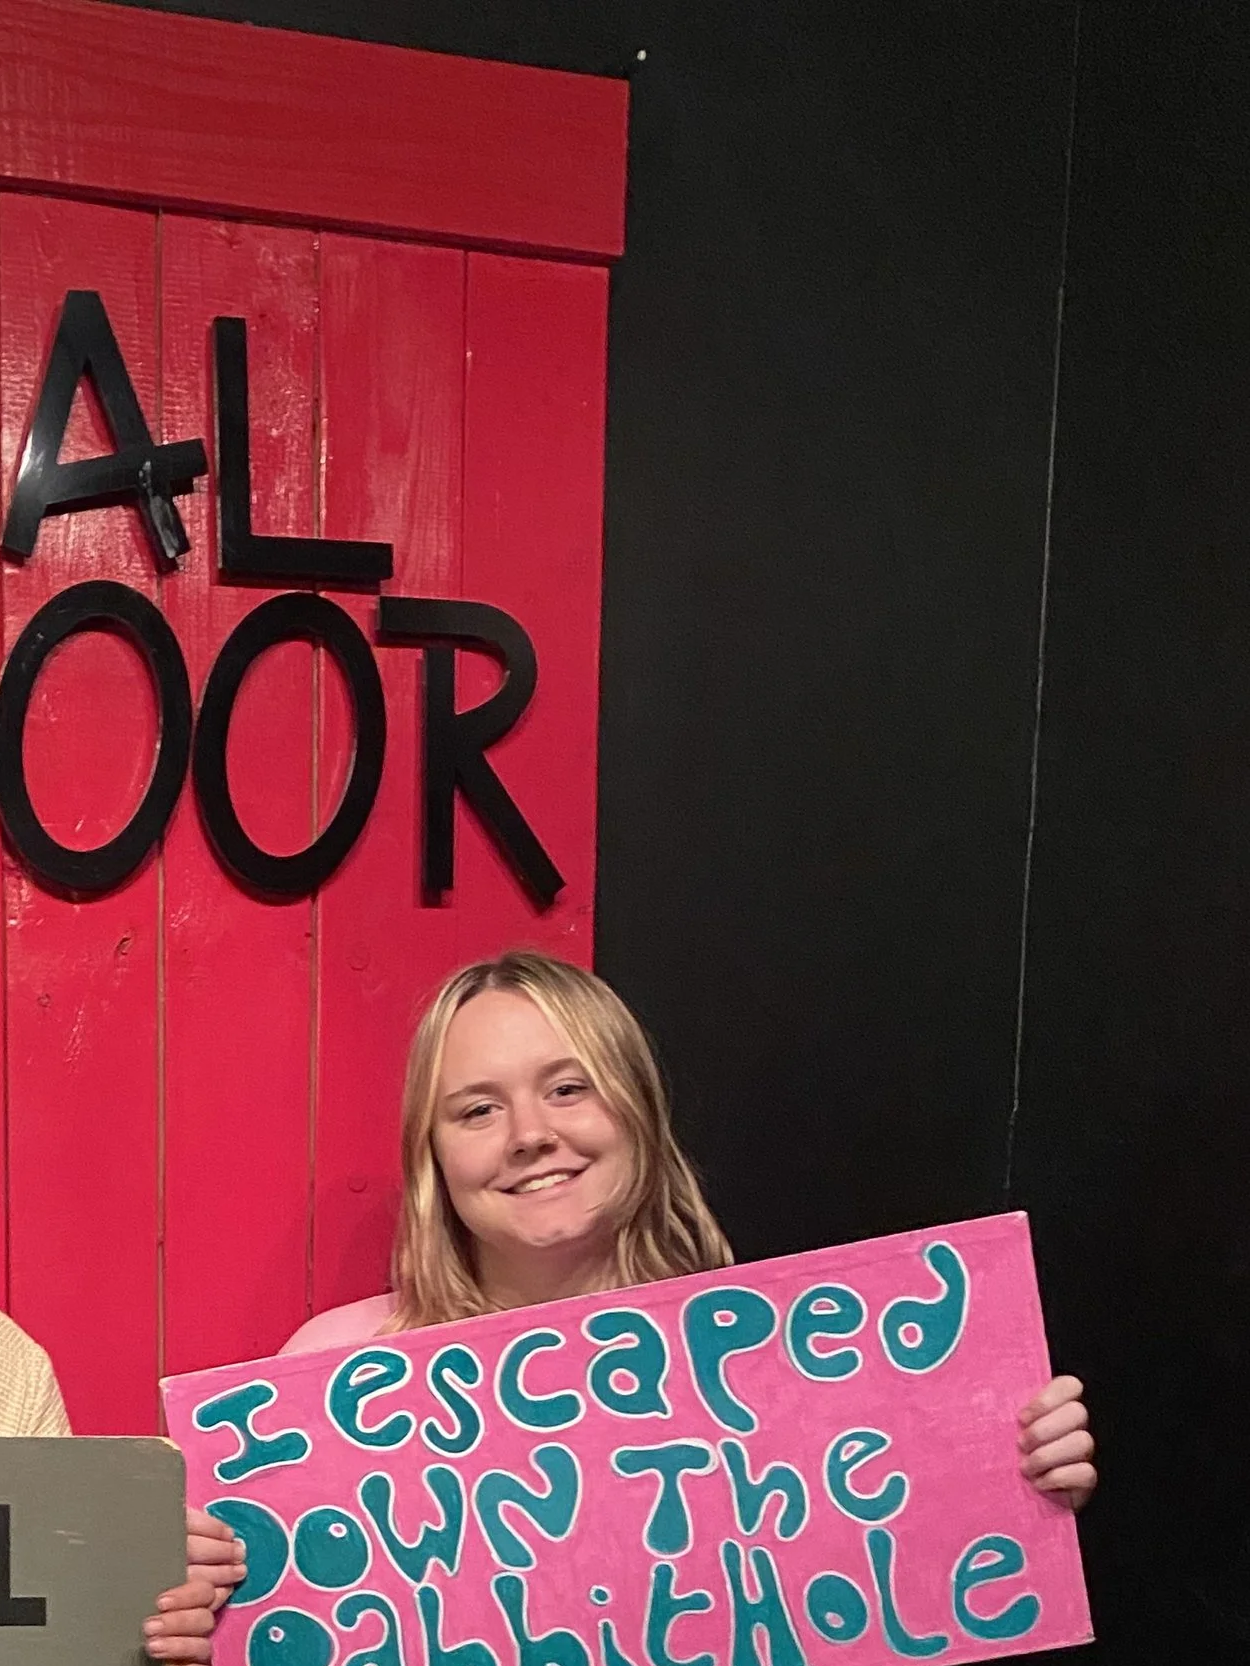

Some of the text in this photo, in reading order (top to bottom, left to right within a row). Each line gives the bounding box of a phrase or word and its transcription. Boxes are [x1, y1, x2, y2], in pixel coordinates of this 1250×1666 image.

[192, 1239, 971, 1485] I escaped
[610, 1427, 910, 1557] The
